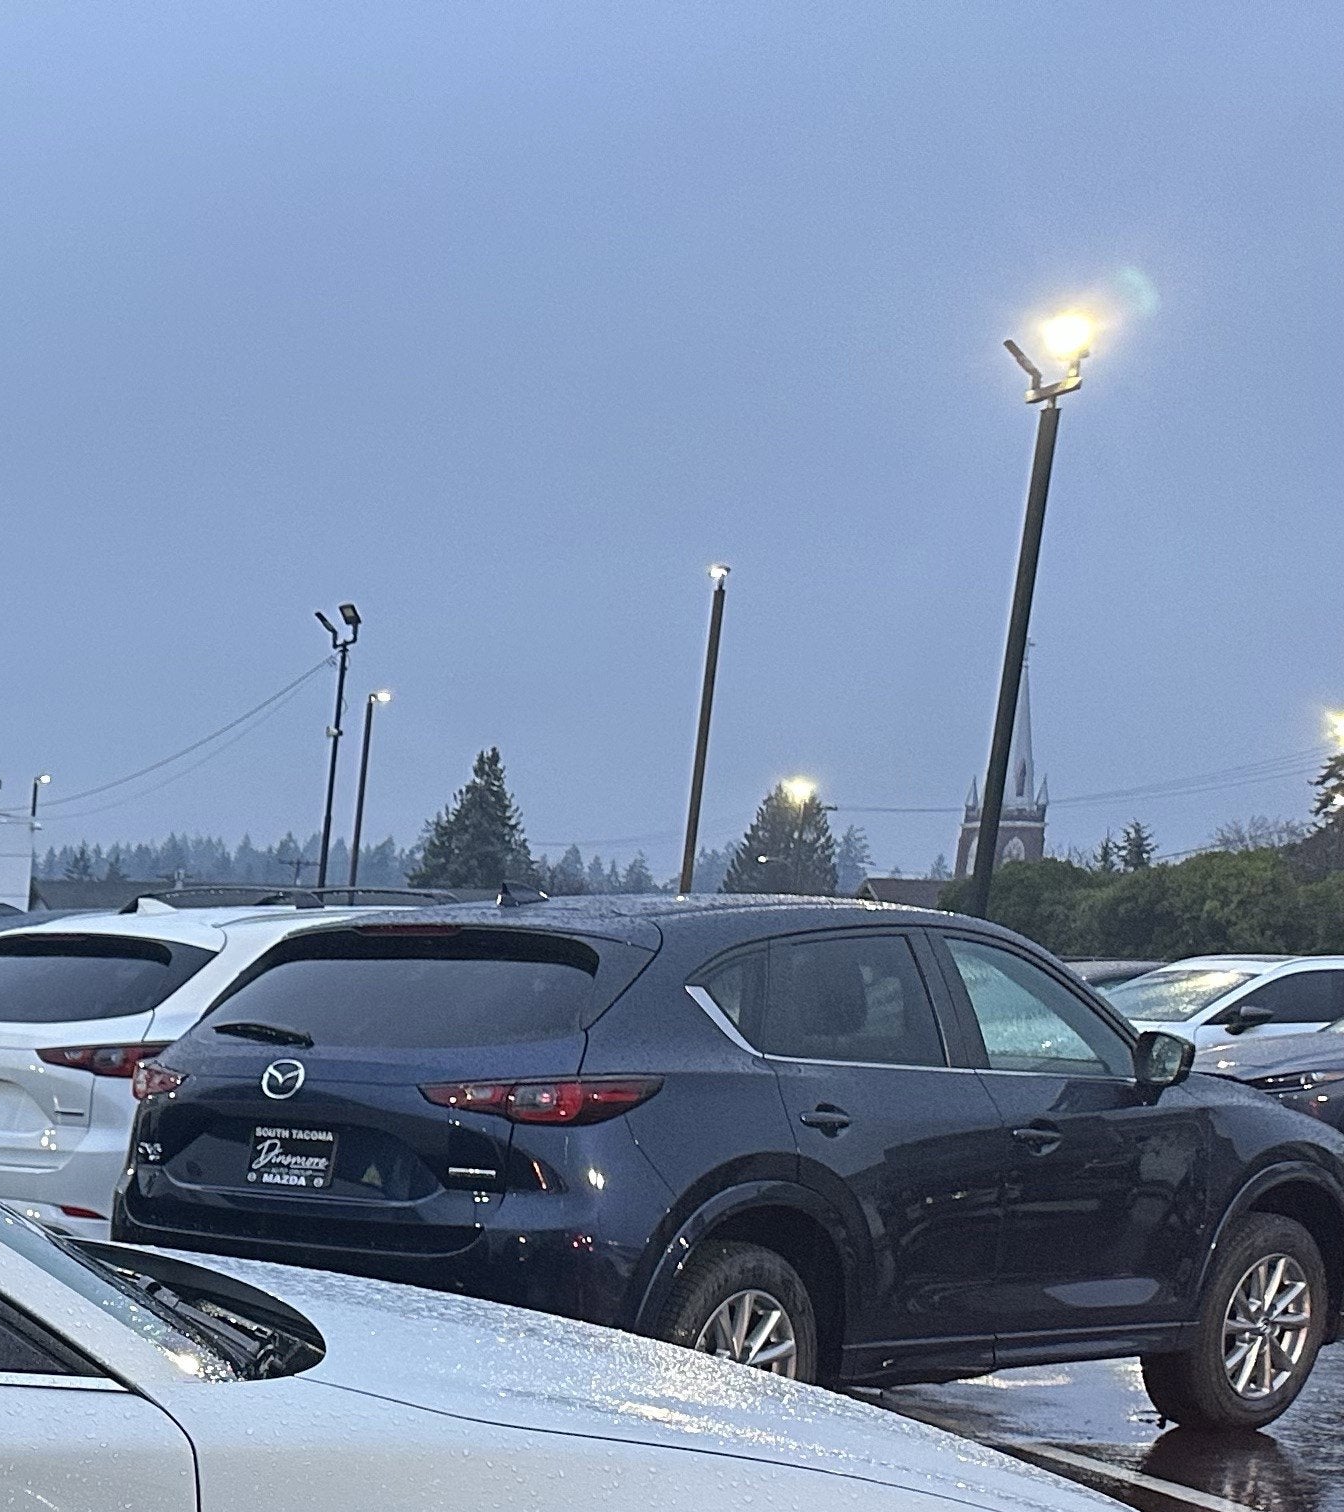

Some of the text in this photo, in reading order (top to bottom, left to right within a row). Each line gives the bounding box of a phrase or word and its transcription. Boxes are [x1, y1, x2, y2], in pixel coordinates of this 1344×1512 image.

[255, 1126, 333, 1141] SOUTH TACOMA
[251, 1138, 329, 1170] Dinsmore
[261, 1173, 306, 1186] MAZDA
